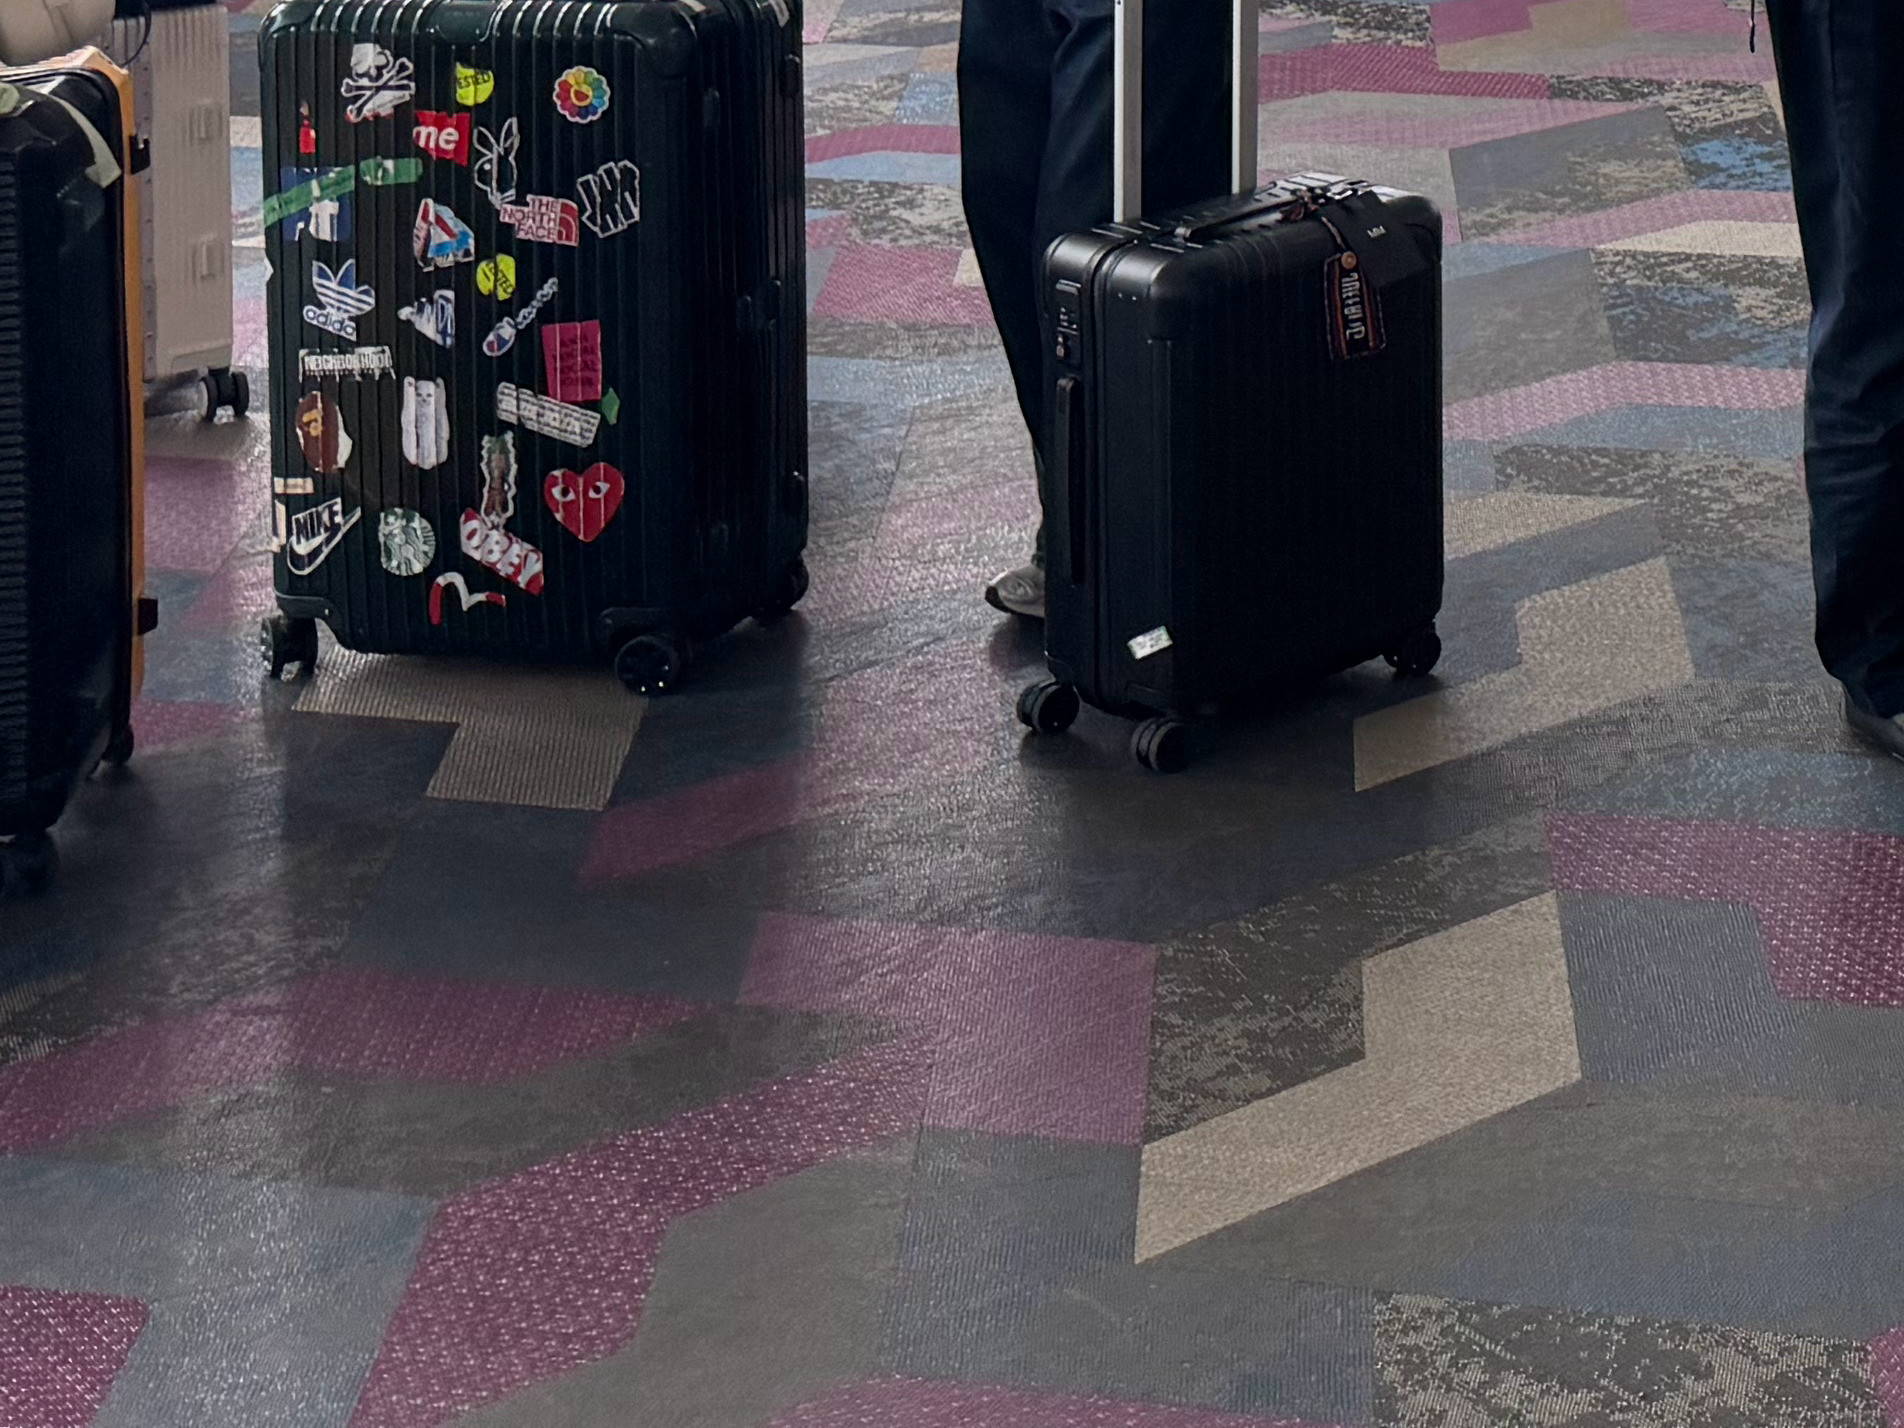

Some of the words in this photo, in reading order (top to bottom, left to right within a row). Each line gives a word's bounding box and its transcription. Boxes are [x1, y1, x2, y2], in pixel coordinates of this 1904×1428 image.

[458, 70, 490, 89] ESTED
[530, 196, 558, 212] THE
[501, 207, 558, 226] NORTH
[516, 222, 558, 240] FACE
[305, 307, 357, 337] adida
[464, 519, 542, 587] OBEY
